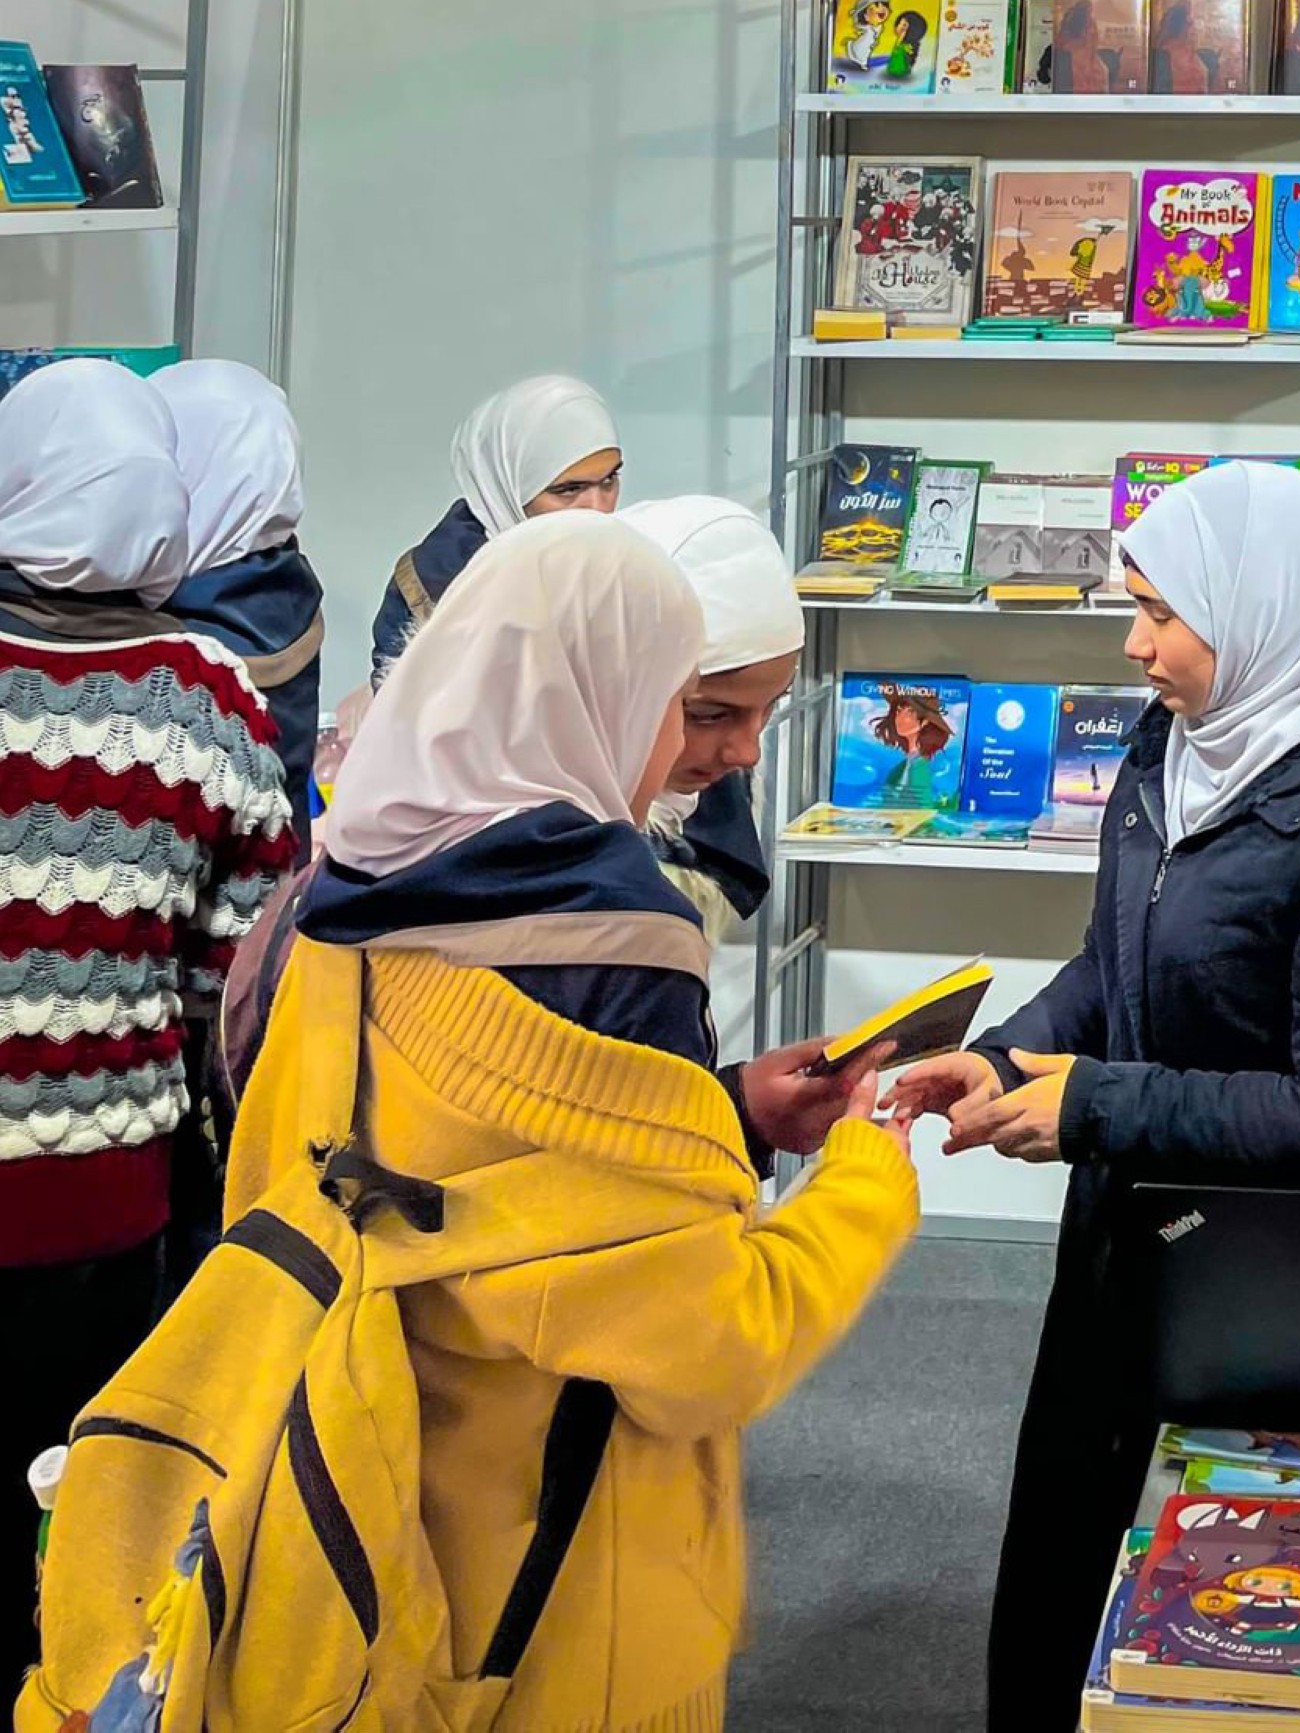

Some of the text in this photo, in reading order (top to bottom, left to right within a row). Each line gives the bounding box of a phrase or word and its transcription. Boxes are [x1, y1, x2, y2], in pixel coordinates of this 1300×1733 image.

[1179, 187, 1232, 201] My Book
[1159, 202, 1250, 226] Animals
[1253, 1646, 1284, 1658] ذات
